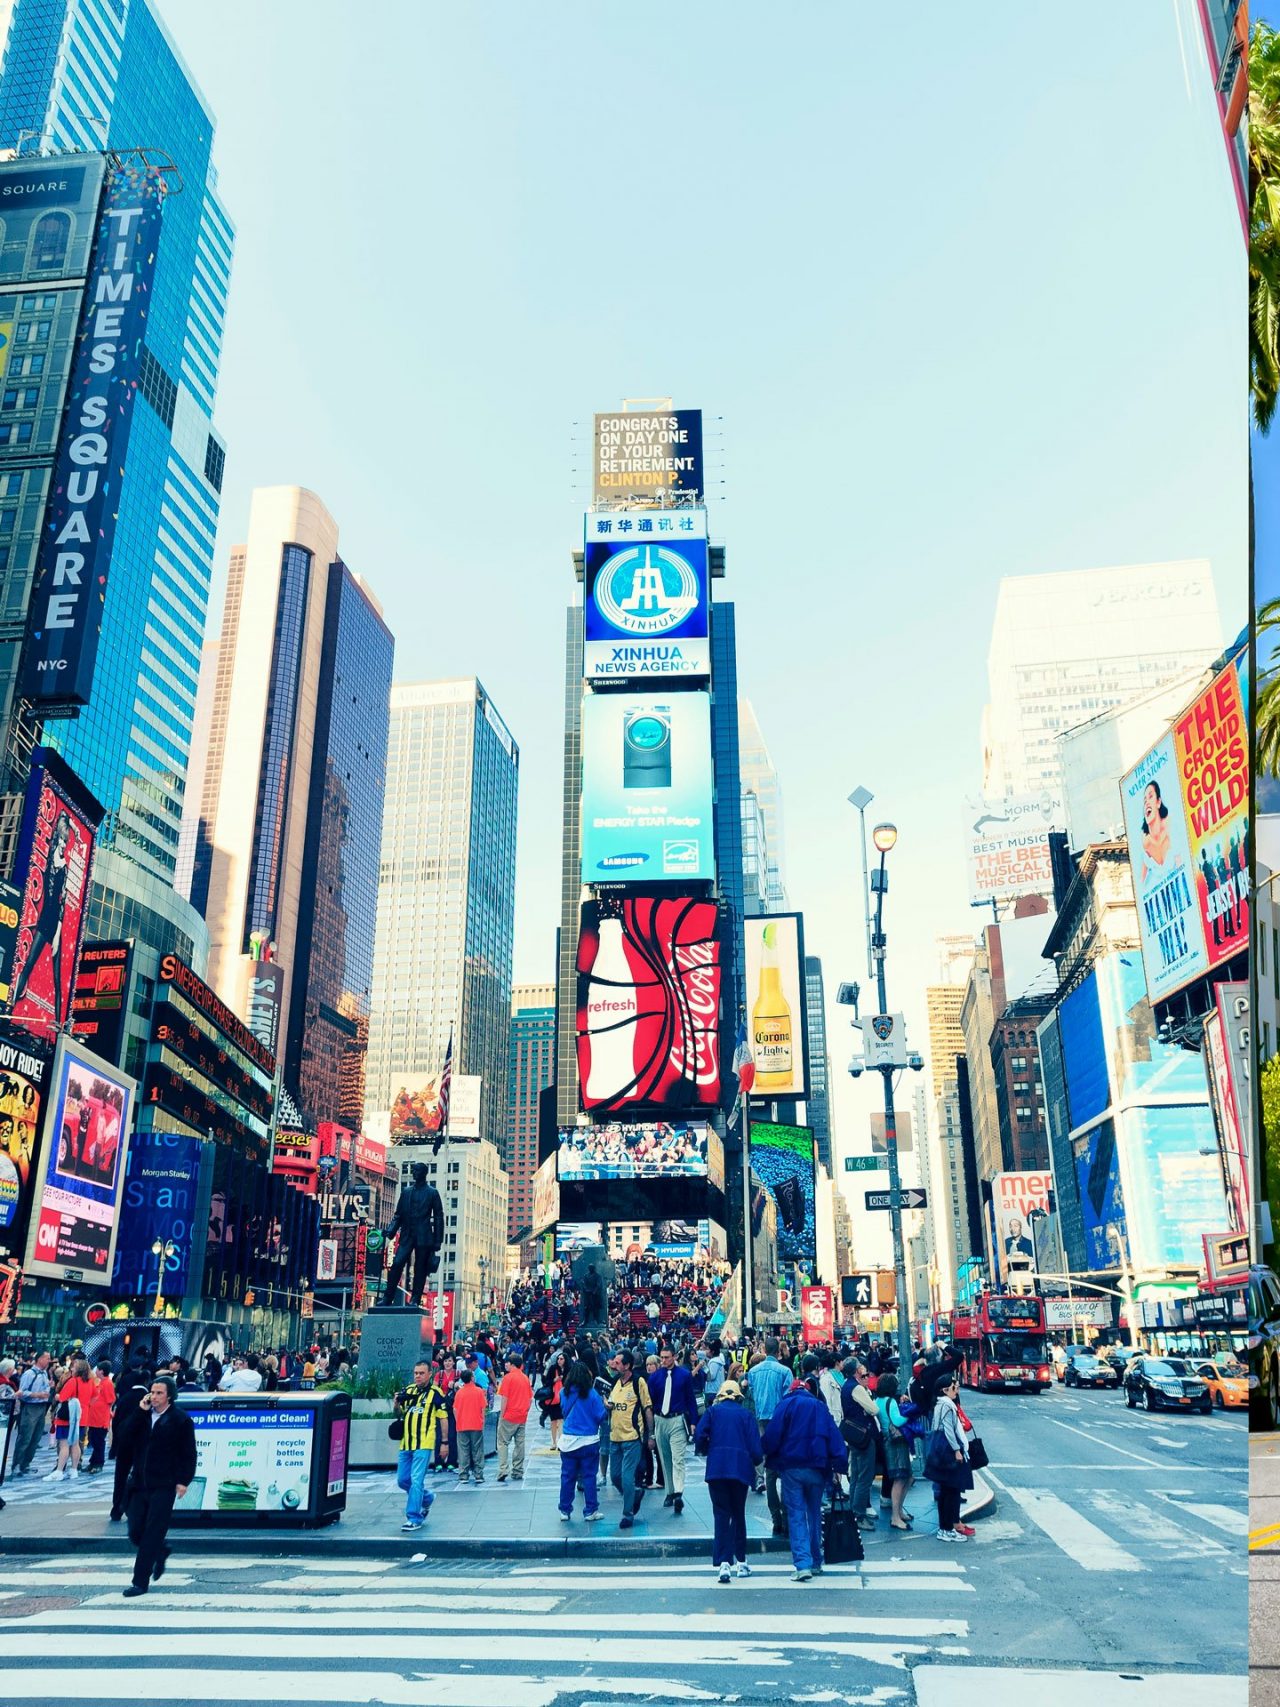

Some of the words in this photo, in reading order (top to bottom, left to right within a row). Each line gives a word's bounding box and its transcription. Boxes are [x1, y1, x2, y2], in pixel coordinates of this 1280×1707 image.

[3, 181, 69, 196] SQUARE
[89, 208, 143, 374] TIMES
[600, 417, 678, 431] CONGRATS
[600, 432, 620, 445] ON
[625, 431, 655, 444] DAY
[658, 430, 688, 443] ONE
[600, 446, 618, 459] OF
[622, 445, 663, 458] YOUR
[600, 472, 662, 486] CLINTON
[668, 471, 683, 484] P.
[44, 396, 109, 630] SQUARE
[597, 517, 694, 533] 新华通讯社
[621, 613, 679, 630] XINHUA
[612, 647, 683, 661] XINHUA
[37, 659, 68, 671] NYC
[595, 661, 636, 673] NEWS
[640, 660, 699, 672] AGENCY
[1177, 672, 1237, 755] THE
[1183, 713, 1240, 779] CROWD
[1187, 737, 1245, 808] GOES
[1191, 765, 1249, 838] WILD!
[627, 806, 649, 814] Take
[652, 806, 668, 814] the
[593, 818, 635, 828] ENERGY
[638, 817, 664, 826] STAR
[667, 817, 700, 827] Pledge
[973, 841, 1003, 854] BEST
[974, 850, 1012, 868] THE
[976, 861, 1042, 880] MUSICAL
[977, 876, 1005, 889] THIS
[1144, 872, 1192, 937] MAMMA
[1207, 875, 1238, 923] JERSEY
[1158, 916, 1188, 969] MIA!
[84, 949, 126, 960] REUTERS
[588, 999, 636, 1012] refresh
[755, 1032, 789, 1045] Corona
[763, 1046, 783, 1056] Light
[17, 1052, 45, 1079] RIDE!
[621, 1122, 657, 1131] HYUNDAI
[275, 1133, 311, 1146] eese's
[846, 1160, 853, 1170] W
[856, 1158, 866, 1169] 46
[142, 1169, 168, 1178] Morgan
[169, 1170, 190, 1180] Stanley
[871, 1195, 889, 1205] ONE
[1003, 1199, 1016, 1209] at
[307, 1193, 363, 1221] HEY'S
[38, 1223, 58, 1248] CNN
[660, 1246, 692, 1254] HYUNDAI
[809, 1289, 827, 1326] tkts
[1089, 1302, 1100, 1310] OF
[376, 1337, 404, 1345] GEORGE
[191, 1415, 204, 1425] eep
[207, 1414, 226, 1423] NYC
[229, 1414, 257, 1423] Green
[259, 1414, 277, 1423] and
[280, 1414, 309, 1423] Clean!
[228, 1440, 257, 1448] recycle
[276, 1439, 306, 1447] recycle
[276, 1449, 305, 1457] bottles
